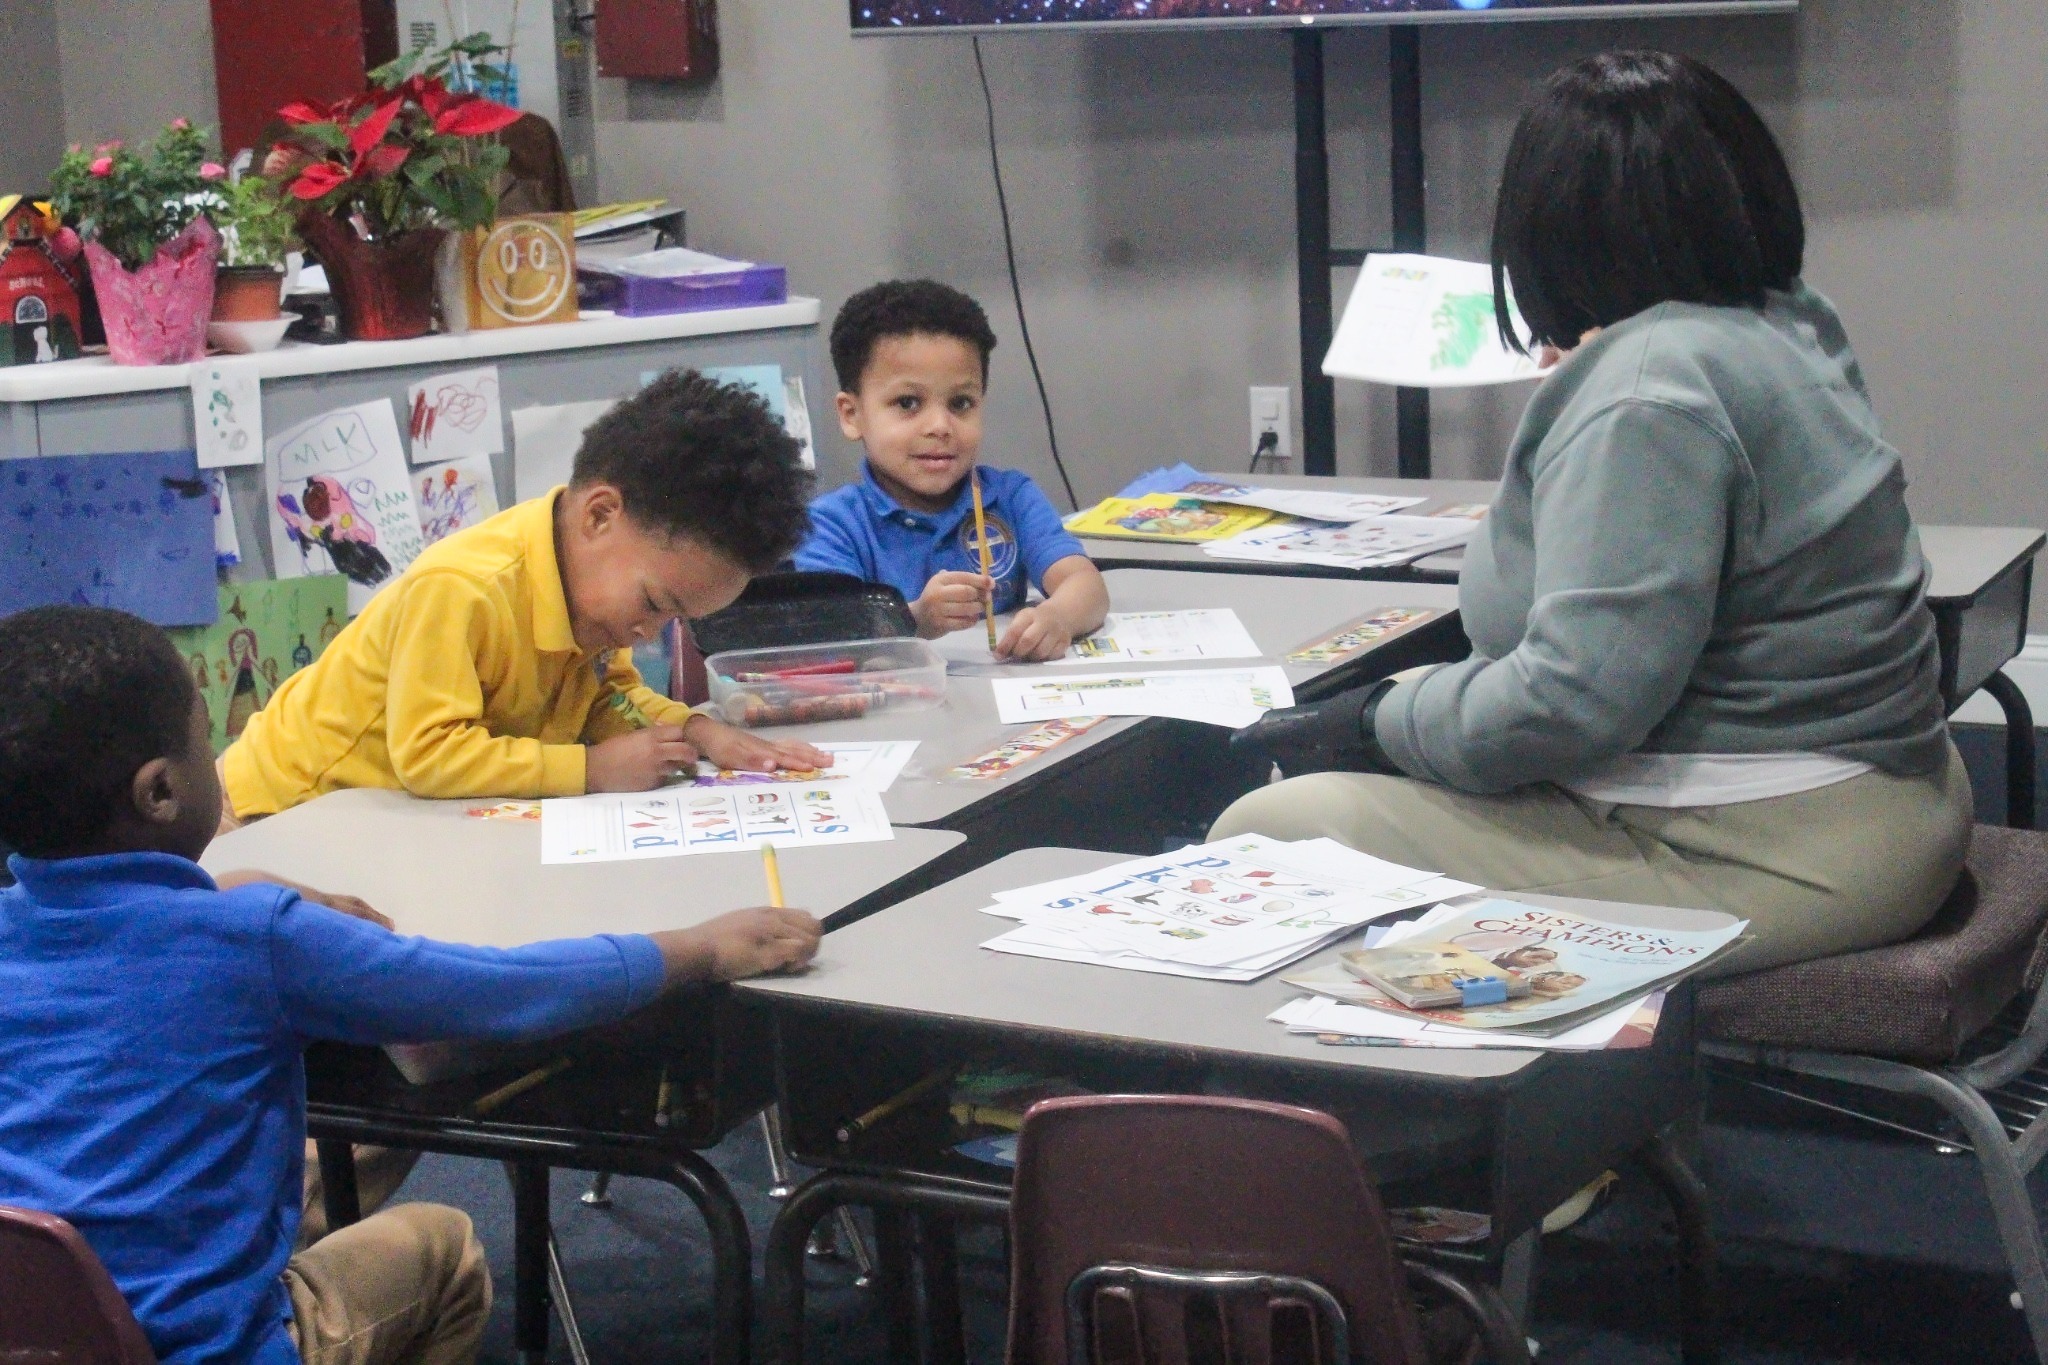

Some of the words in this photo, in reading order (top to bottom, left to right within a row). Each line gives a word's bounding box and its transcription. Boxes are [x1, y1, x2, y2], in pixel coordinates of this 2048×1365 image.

[294, 422, 364, 465] MLK
[632, 835, 678, 850] p
[689, 828, 738, 846] k
[1176, 856, 1231, 869] p
[1129, 866, 1178, 884] k
[1473, 918, 1705, 956] CHAMPIONS
[1513, 911, 1653, 945] SISTERS
